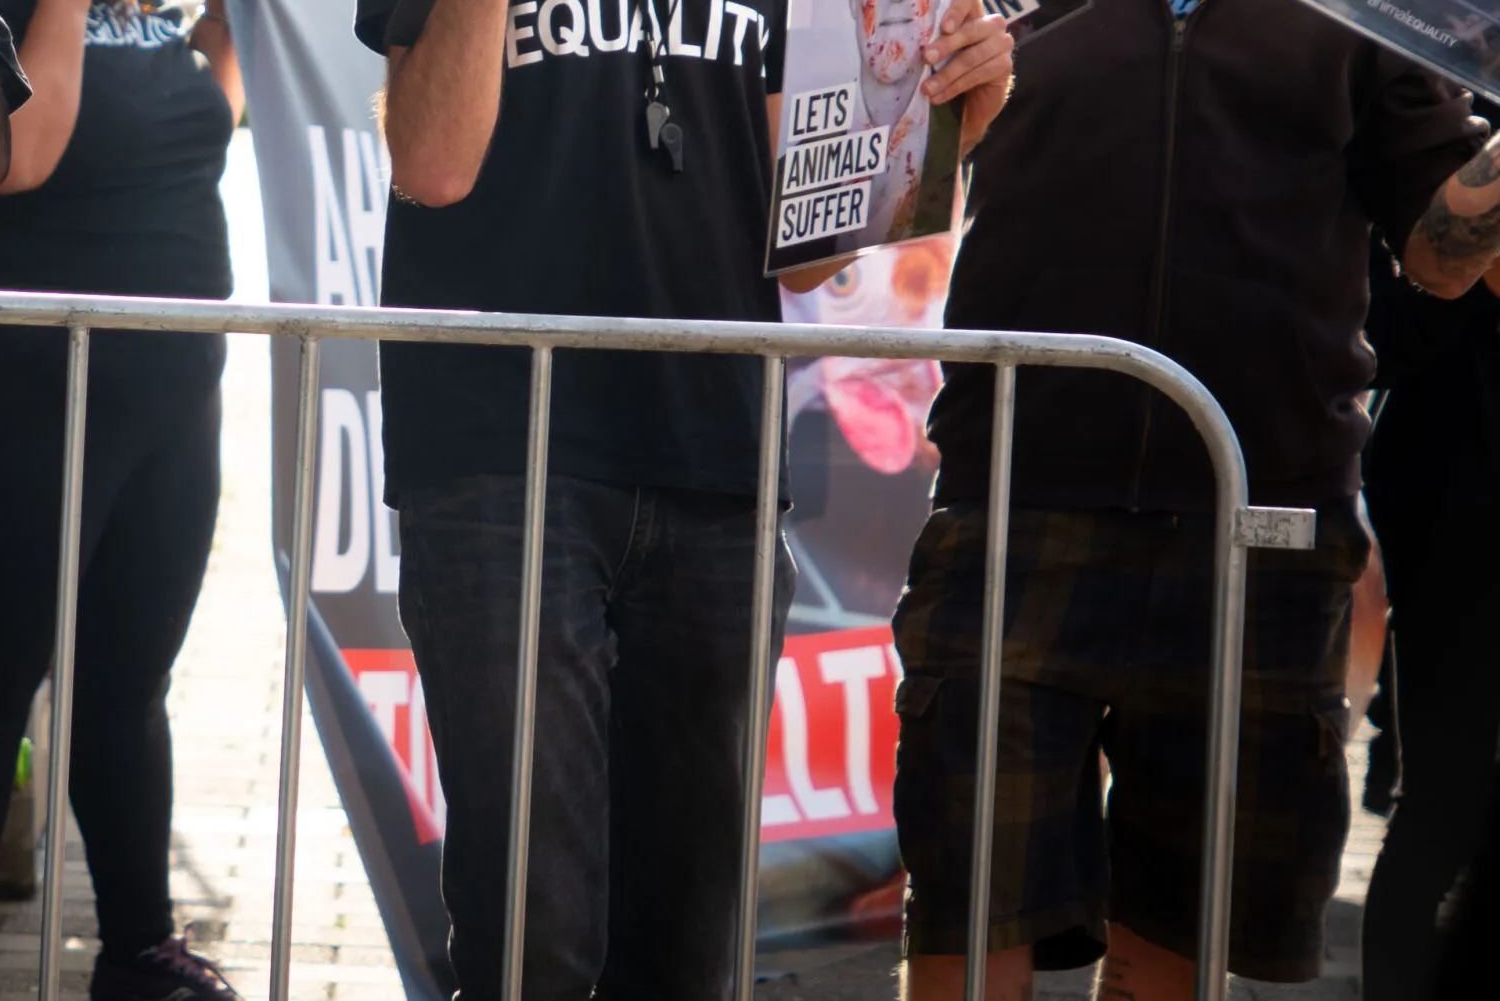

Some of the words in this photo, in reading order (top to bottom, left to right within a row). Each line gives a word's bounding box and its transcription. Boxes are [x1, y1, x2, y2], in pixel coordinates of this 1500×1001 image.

[793, 89, 848, 136] LETS
[787, 132, 881, 190] ANIMALS
[782, 188, 864, 242] SUFFER
